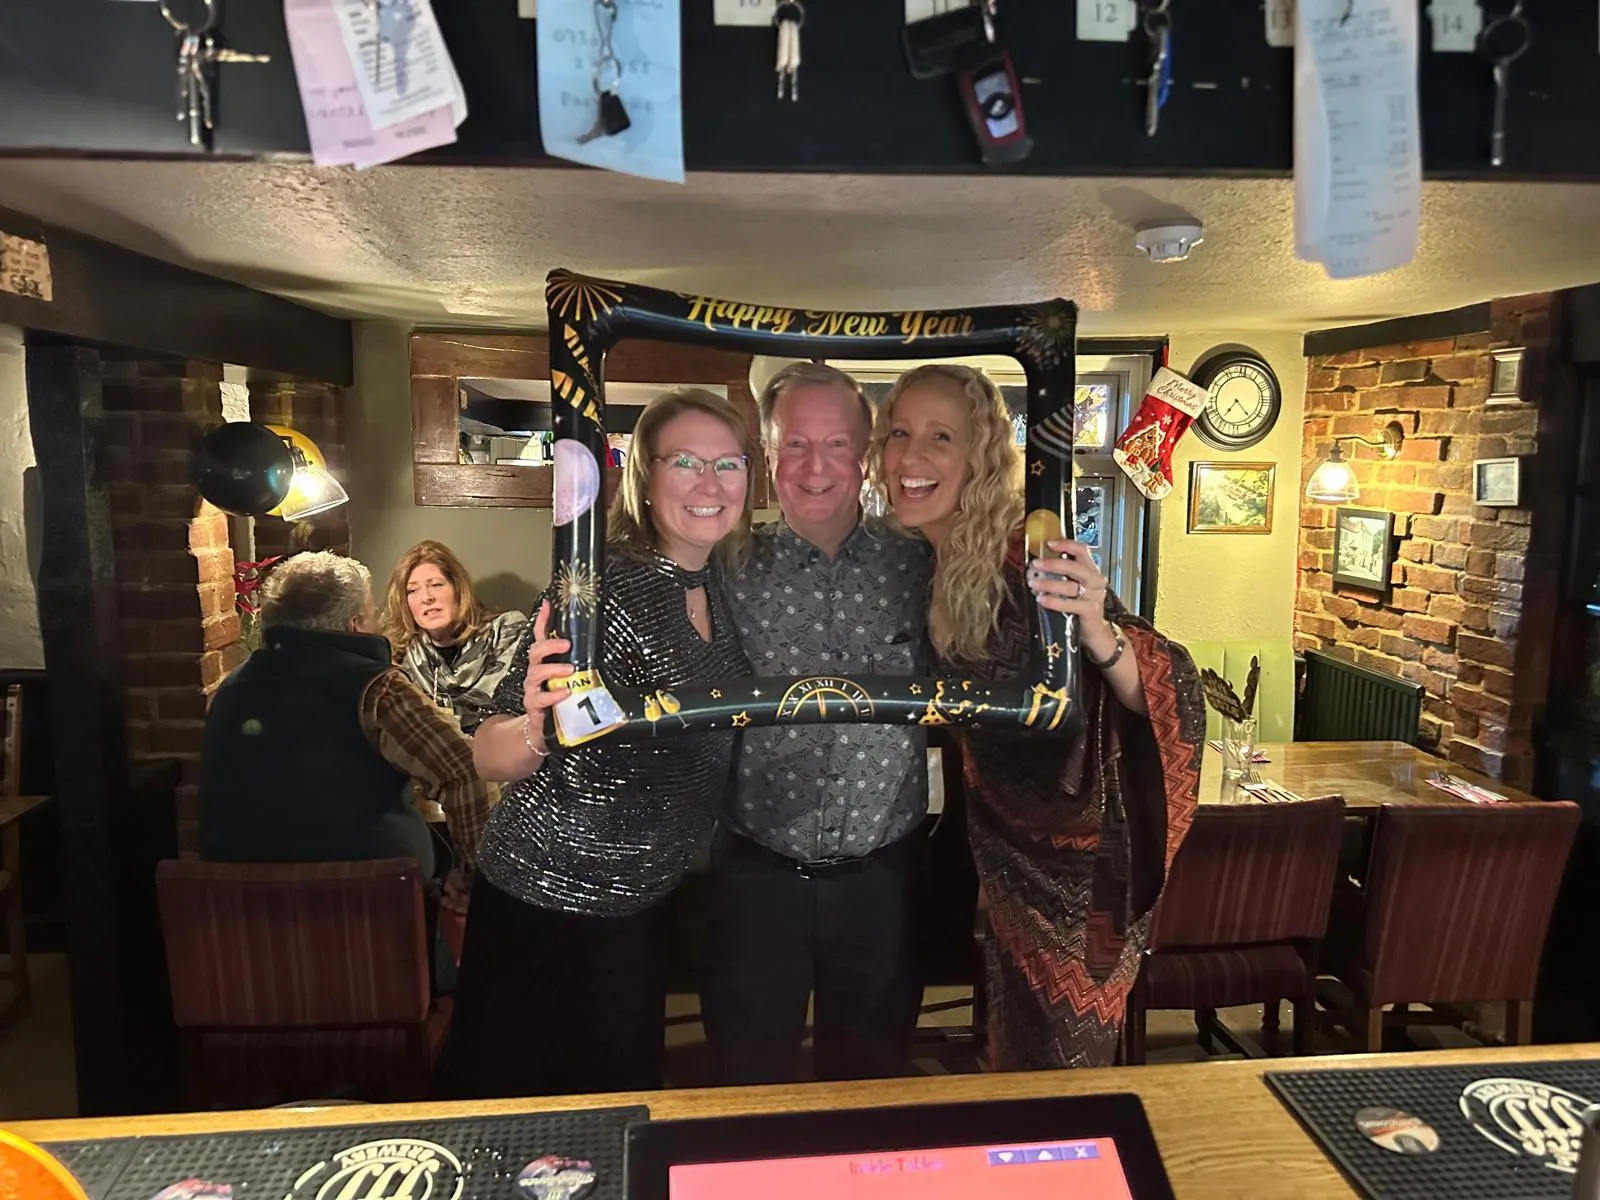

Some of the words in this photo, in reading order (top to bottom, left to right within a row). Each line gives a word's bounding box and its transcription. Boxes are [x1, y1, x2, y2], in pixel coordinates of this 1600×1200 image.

[1095, 3, 1117, 23] 12
[1442, 12, 1463, 34] 14
[677, 292, 795, 335] Happy
[804, 310, 890, 337] New
[892, 310, 976, 344] Year
[1156, 385, 1198, 410] Christmas
[1166, 379, 1197, 401] Merry
[576, 696, 602, 726] 1
[341, 1144, 436, 1168] BREWERY
